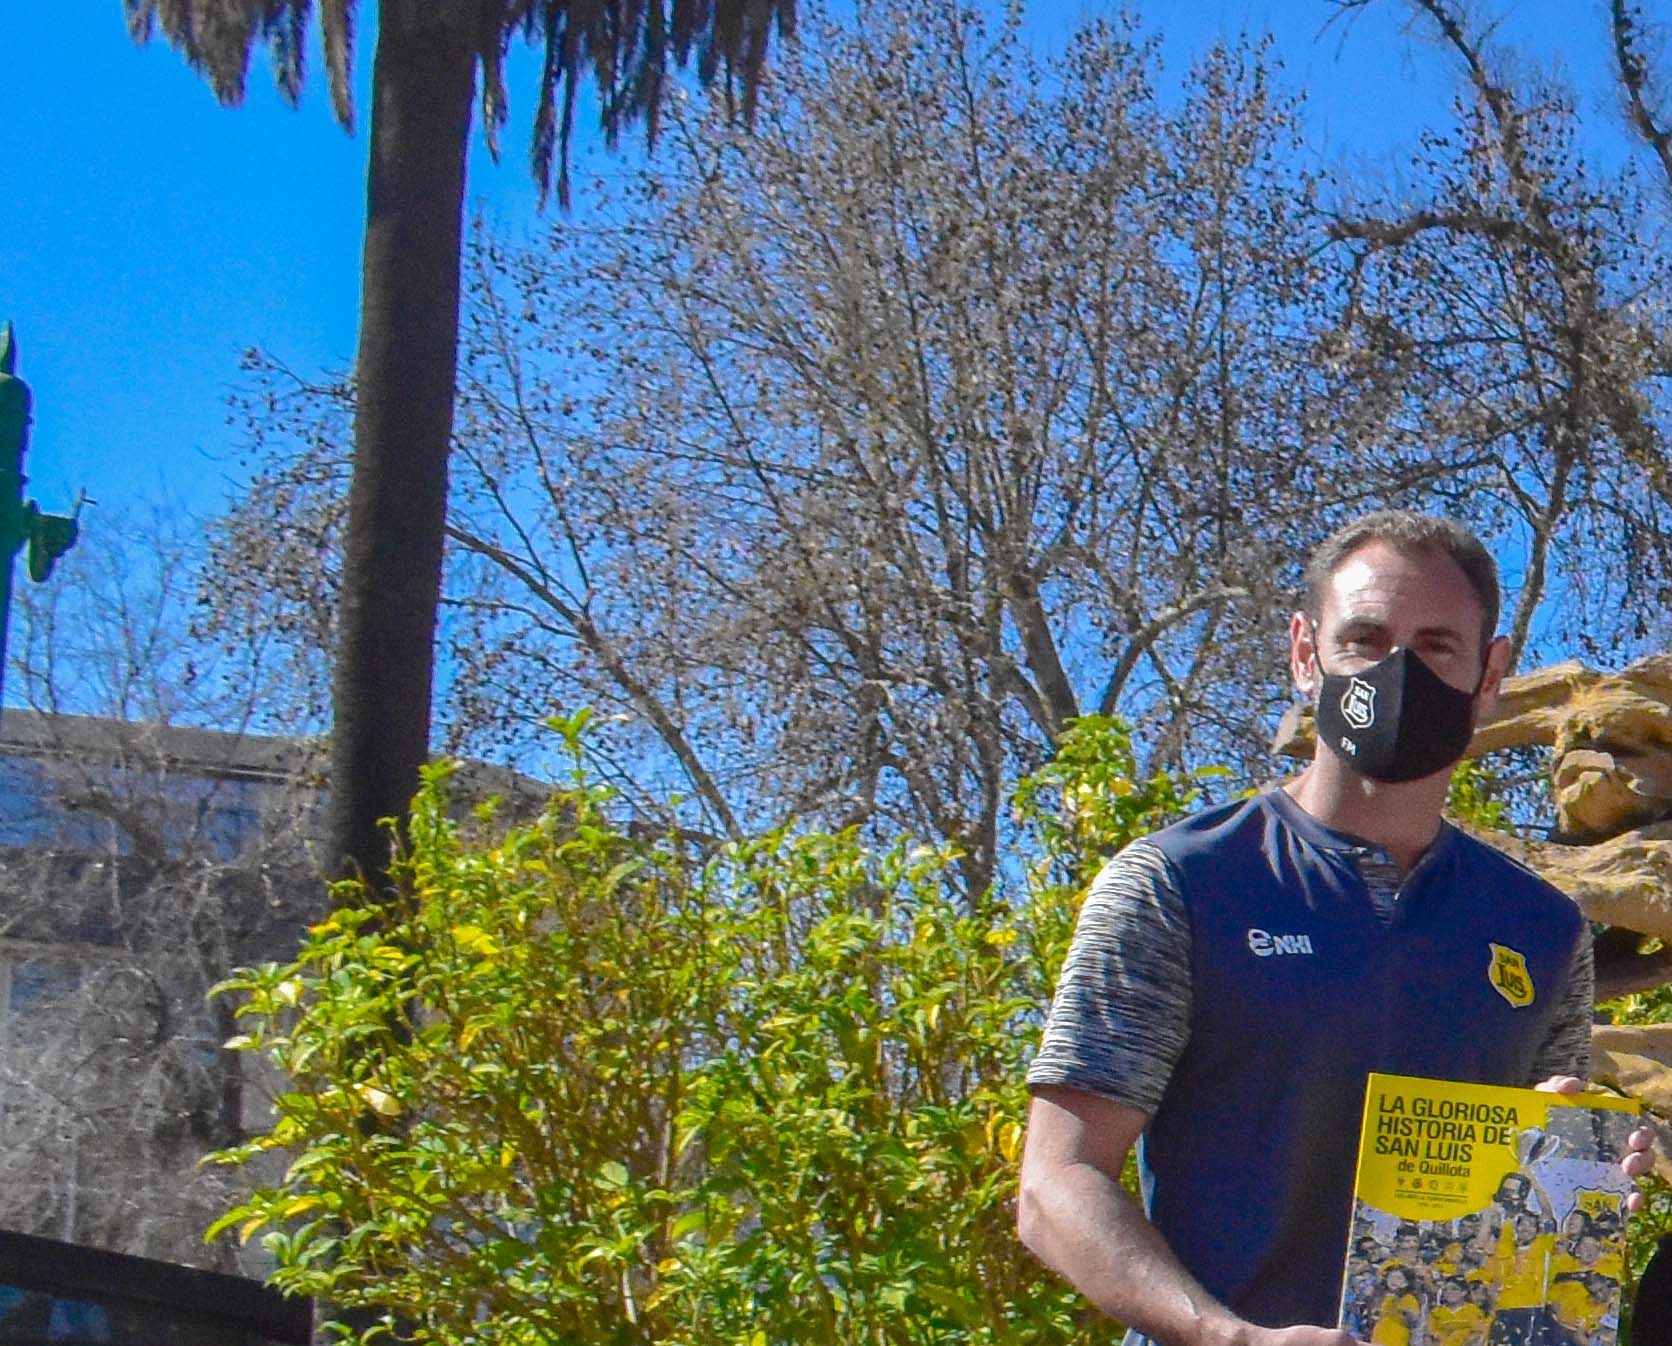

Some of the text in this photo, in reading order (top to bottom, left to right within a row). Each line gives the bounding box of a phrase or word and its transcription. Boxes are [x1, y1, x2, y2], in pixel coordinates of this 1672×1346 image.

[1354, 685, 1370, 702] SAN
[1379, 1094, 1518, 1125] LA GLORIOSA
[1377, 1114, 1511, 1147] HISTORIA DE
[1375, 1136, 1473, 1163] SAN LUIS
[1397, 1160, 1471, 1178] de Quillota
